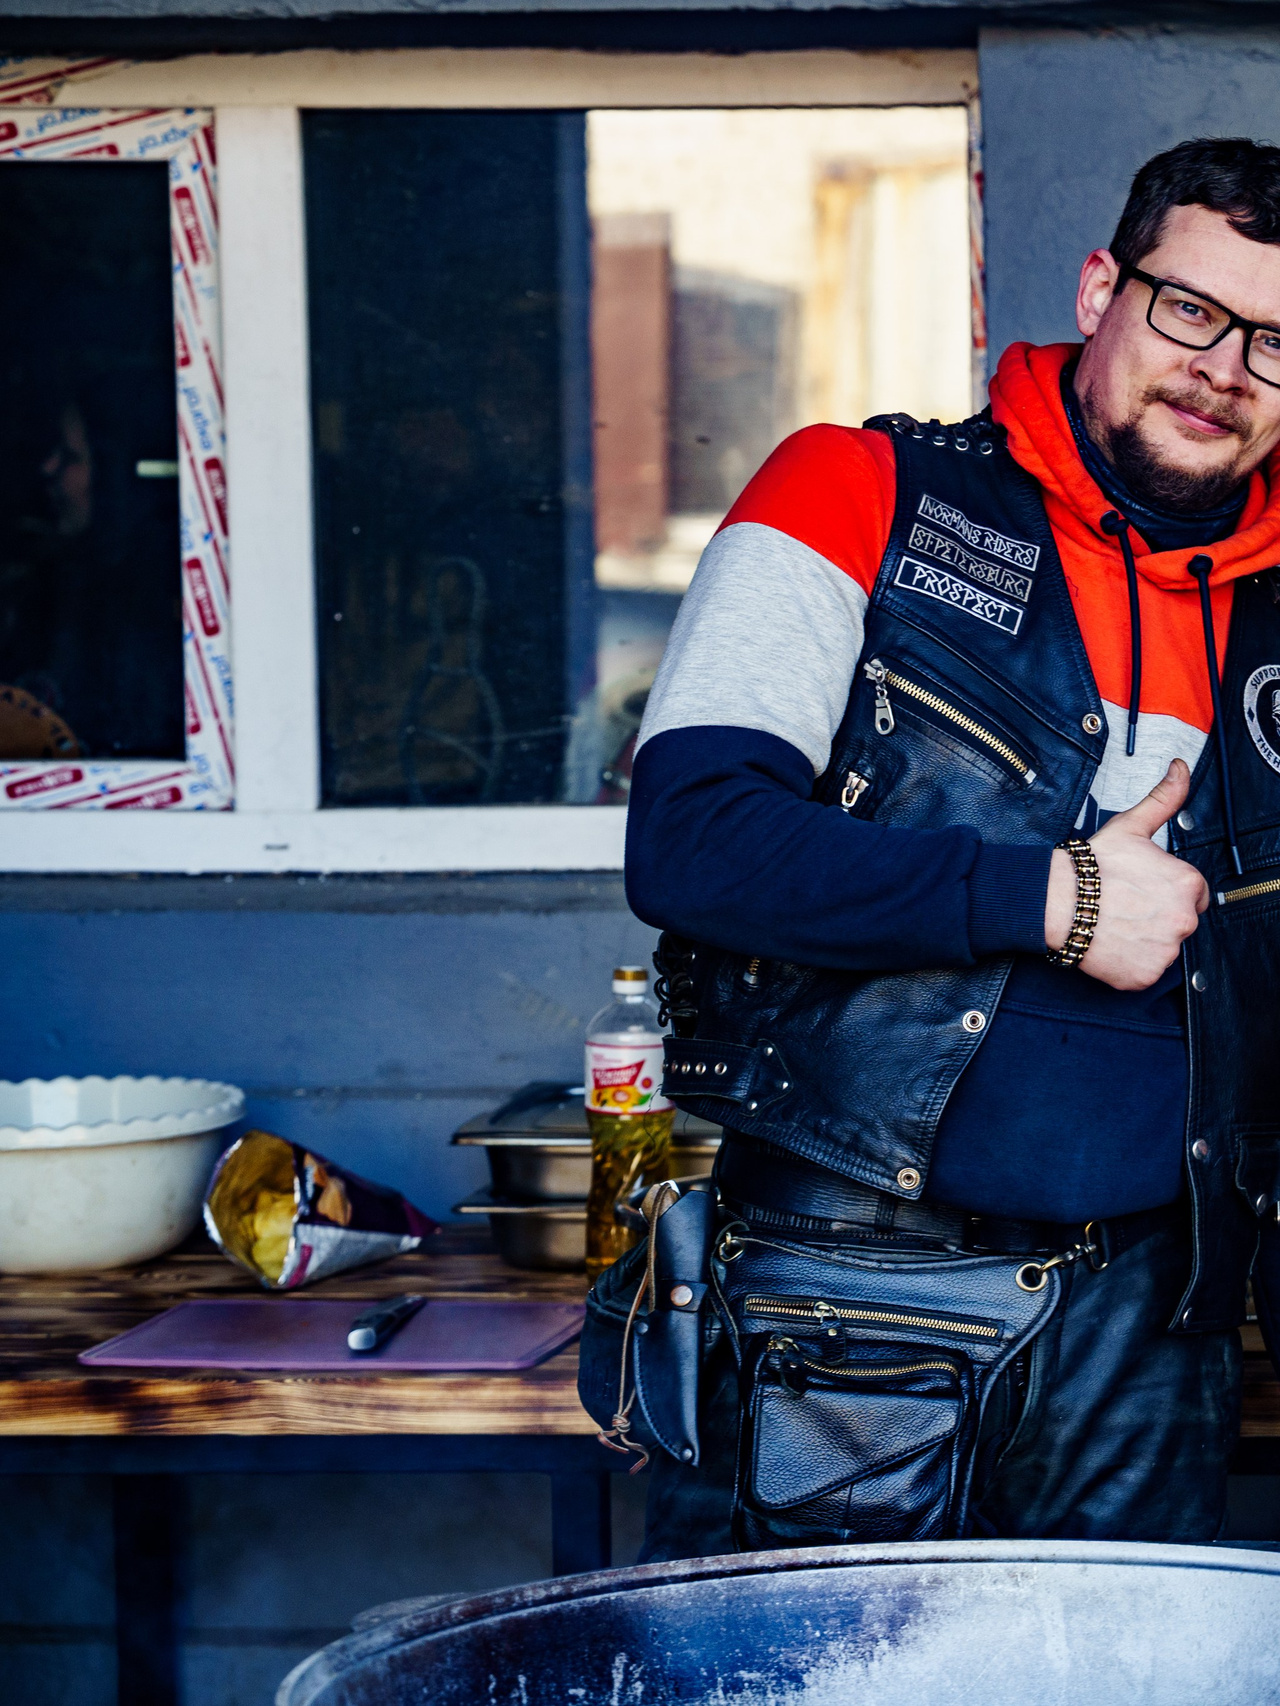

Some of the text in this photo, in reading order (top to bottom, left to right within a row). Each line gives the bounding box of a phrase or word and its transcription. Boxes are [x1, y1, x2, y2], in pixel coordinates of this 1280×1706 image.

[924, 499, 1035, 565] NORMANS RIDERS
[912, 565, 1010, 623] PROSPECT
[1255, 735, 1272, 760] THE
